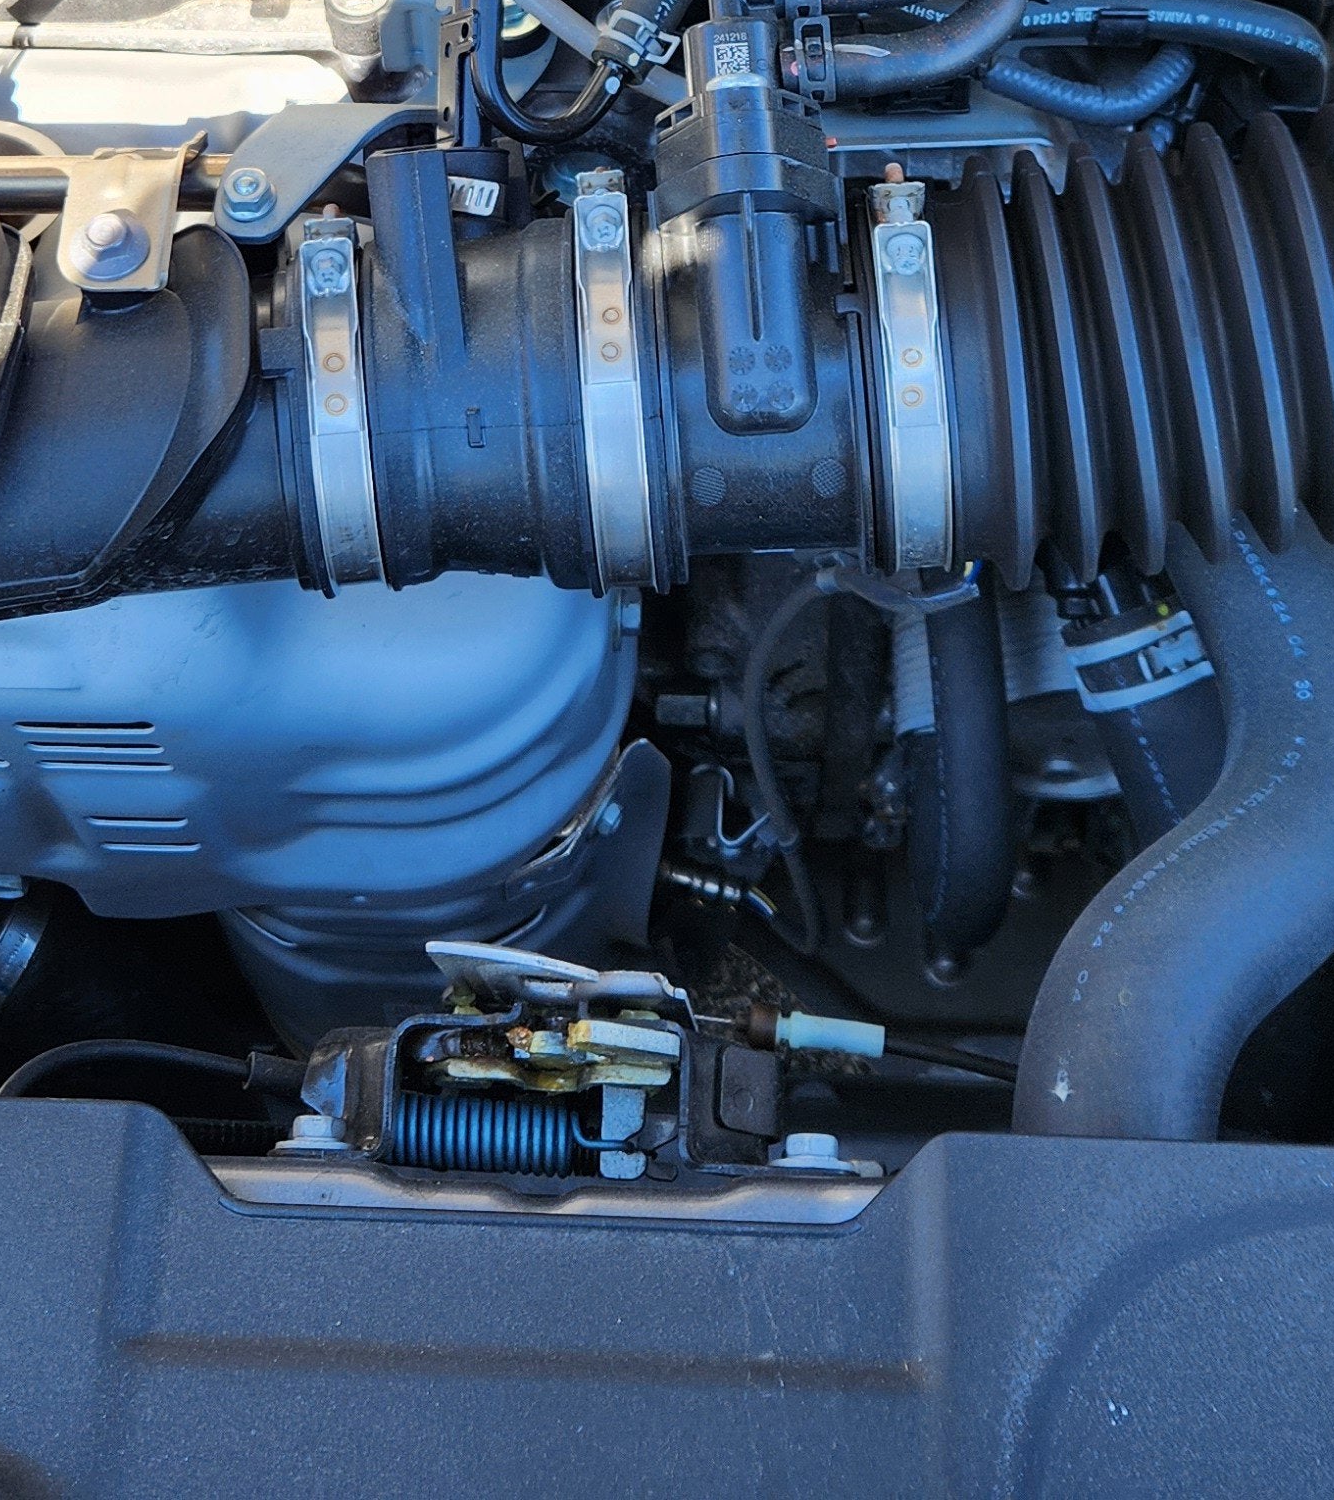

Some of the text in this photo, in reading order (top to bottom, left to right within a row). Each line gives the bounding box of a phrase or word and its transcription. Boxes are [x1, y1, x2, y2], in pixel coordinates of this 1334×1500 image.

[900, 4, 950, 23] ASHIT
[1148, 9, 1192, 26] YAMAS
[1293, 678, 1315, 702] 30
